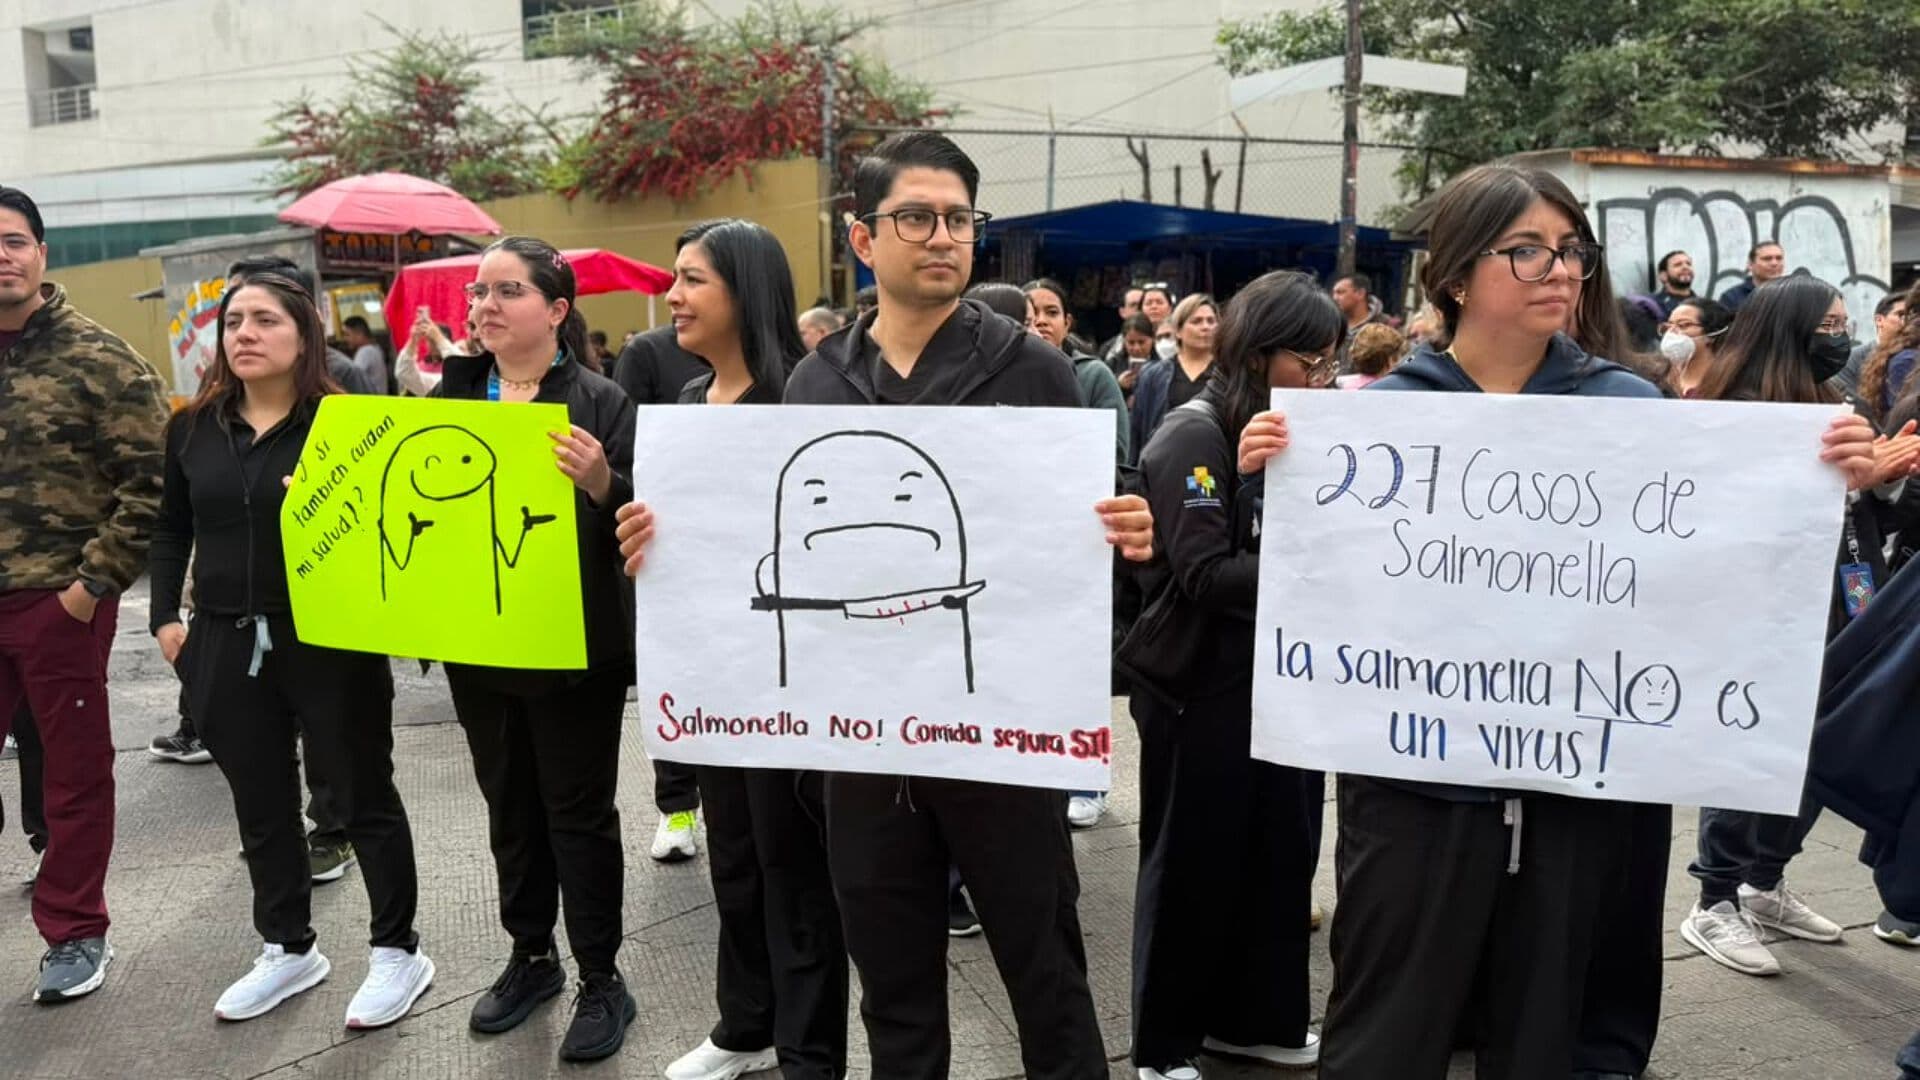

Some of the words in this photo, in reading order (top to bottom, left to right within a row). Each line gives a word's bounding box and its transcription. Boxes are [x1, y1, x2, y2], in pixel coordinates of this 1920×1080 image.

[1316, 443, 1441, 514] 227
[1462, 448, 1602, 528] Casos
[1632, 471, 1696, 539] de
[296, 557, 314, 579] mi
[1383, 518, 1636, 608] Salmonella
[657, 692, 808, 742] Salmonella
[829, 715, 883, 746] NO!
[900, 715, 982, 745] Comida
[993, 727, 1066, 755] segura
[1335, 644, 1552, 707] salmonella
[1718, 679, 1761, 730] es
[1389, 711, 1446, 761] un
